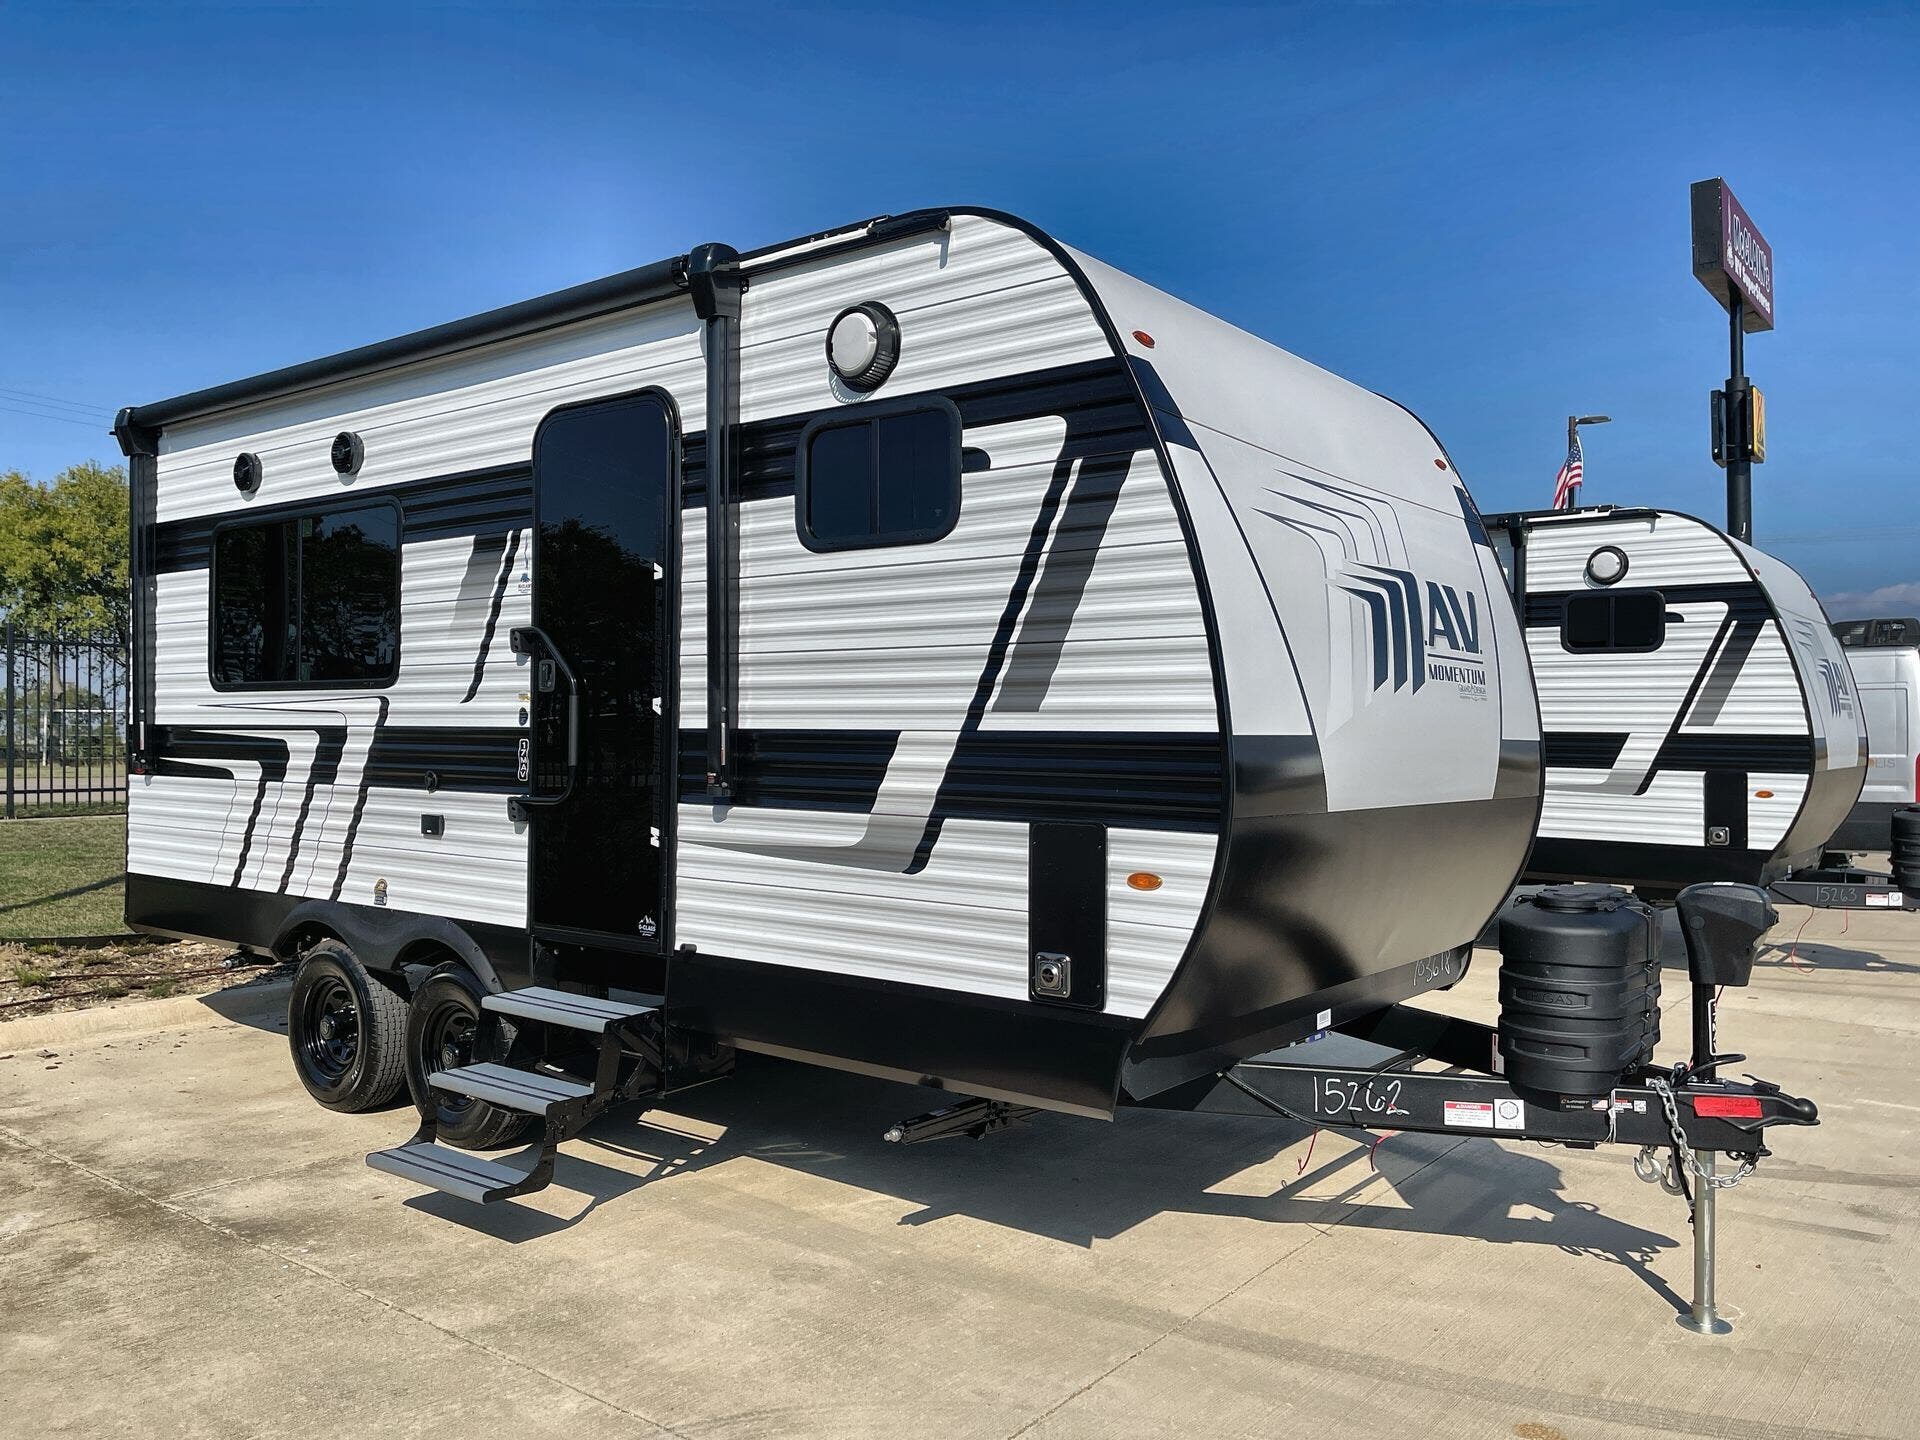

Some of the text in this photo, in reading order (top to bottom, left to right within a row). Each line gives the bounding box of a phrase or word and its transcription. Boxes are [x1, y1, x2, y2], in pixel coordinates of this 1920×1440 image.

[1734, 255, 1742, 279] RV
[1428, 664, 1486, 686] MOMENTUM
[1816, 886, 1858, 902] 15263
[1313, 1076, 1410, 1115] 15262
